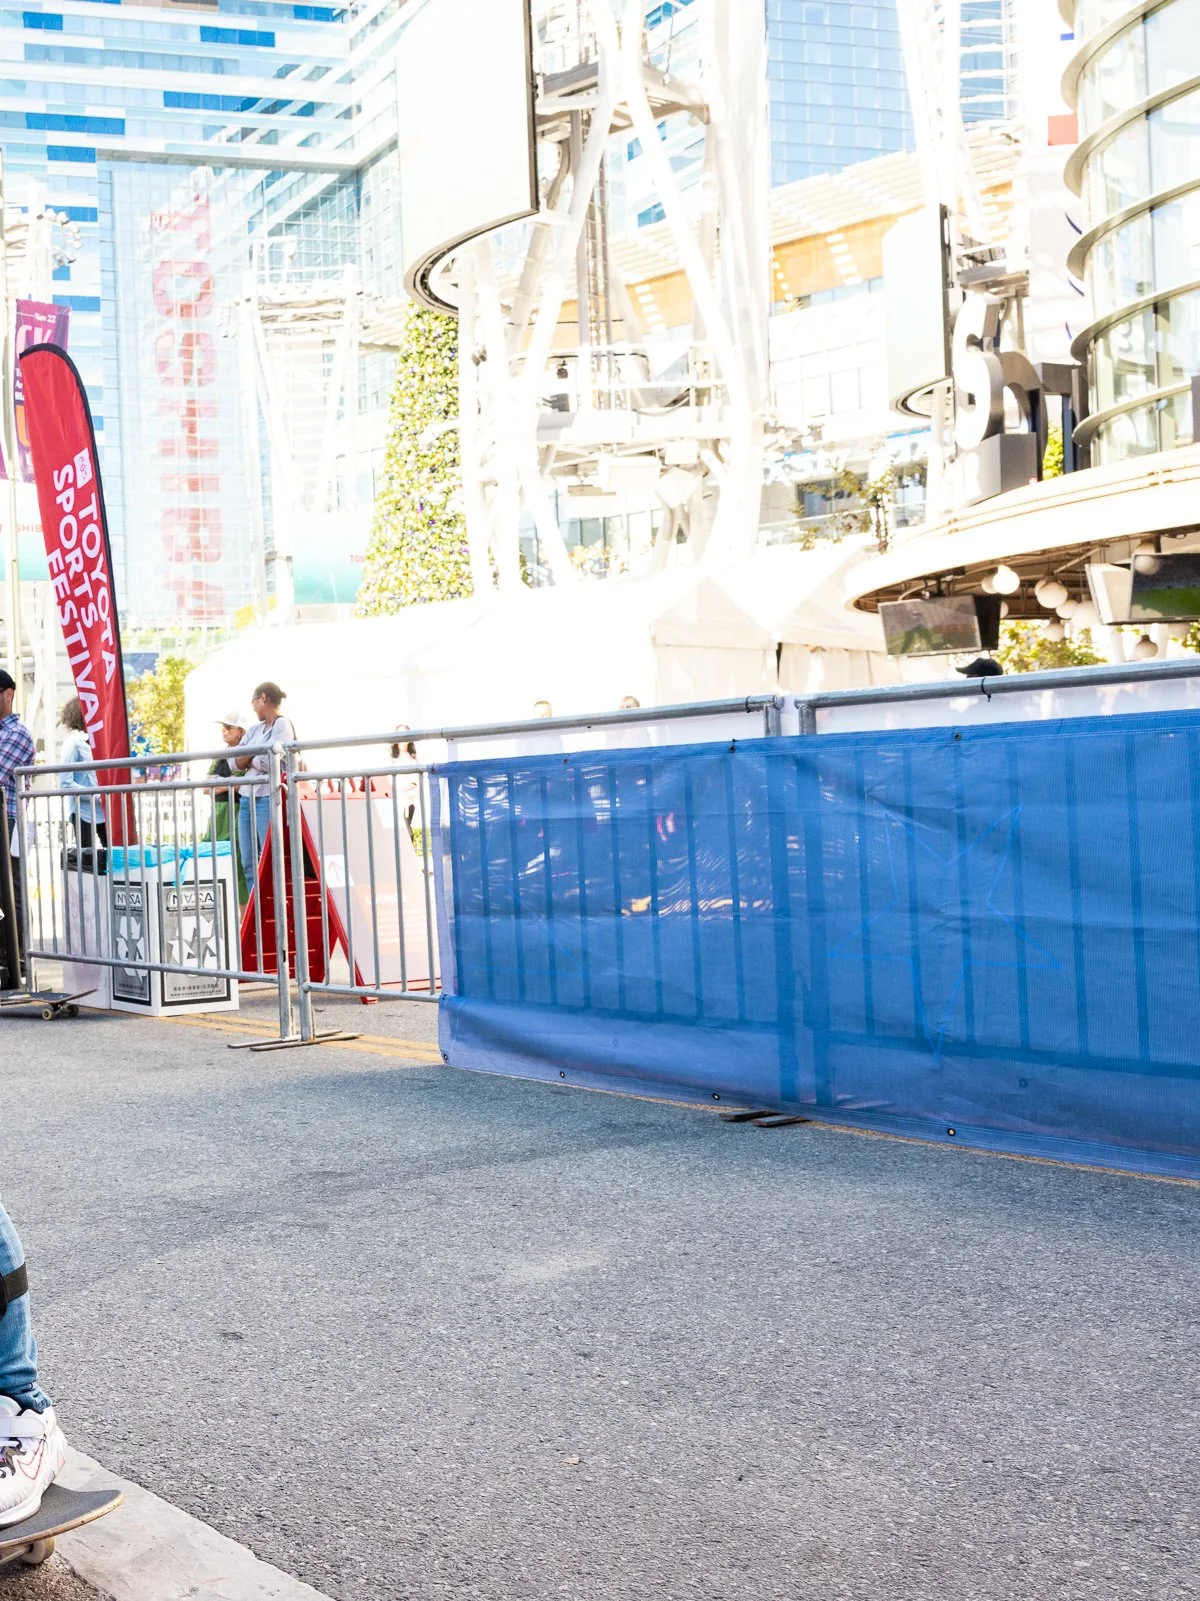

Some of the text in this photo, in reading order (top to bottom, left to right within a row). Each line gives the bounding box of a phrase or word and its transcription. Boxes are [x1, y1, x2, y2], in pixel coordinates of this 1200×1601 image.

[34, 312, 57, 323] Nov 22
[53, 463, 99, 630] SPORTS
[79, 491, 116, 684] TOYOTA
[47, 547, 104, 749] FESTIVAL
